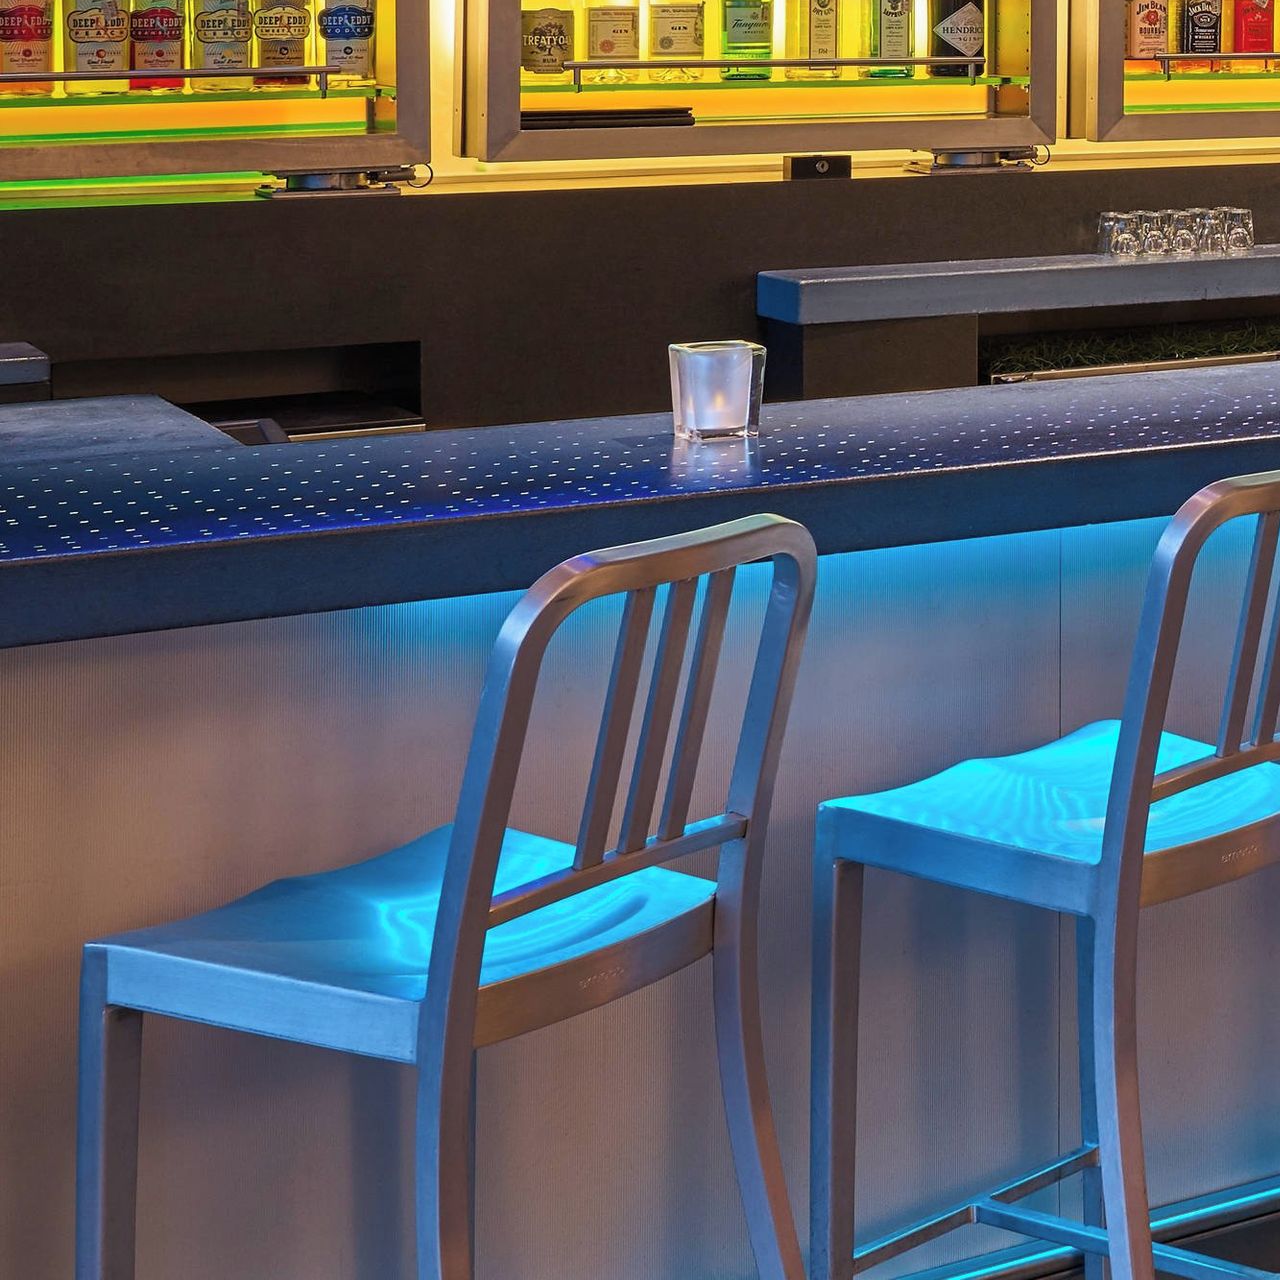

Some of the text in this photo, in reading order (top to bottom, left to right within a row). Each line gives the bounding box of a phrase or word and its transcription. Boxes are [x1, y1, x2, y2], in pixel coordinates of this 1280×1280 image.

[1136, 3, 1150, 15] JIM
[0, 17, 22, 26] DEEP
[73, 17, 125, 28] DEEP EDDY
[132, 18, 156, 28] DEEP
[201, 19, 223, 29] DEEP
[258, 16, 307, 25] DEEP EDDY
[322, 15, 371, 25] DEEP EDDY
